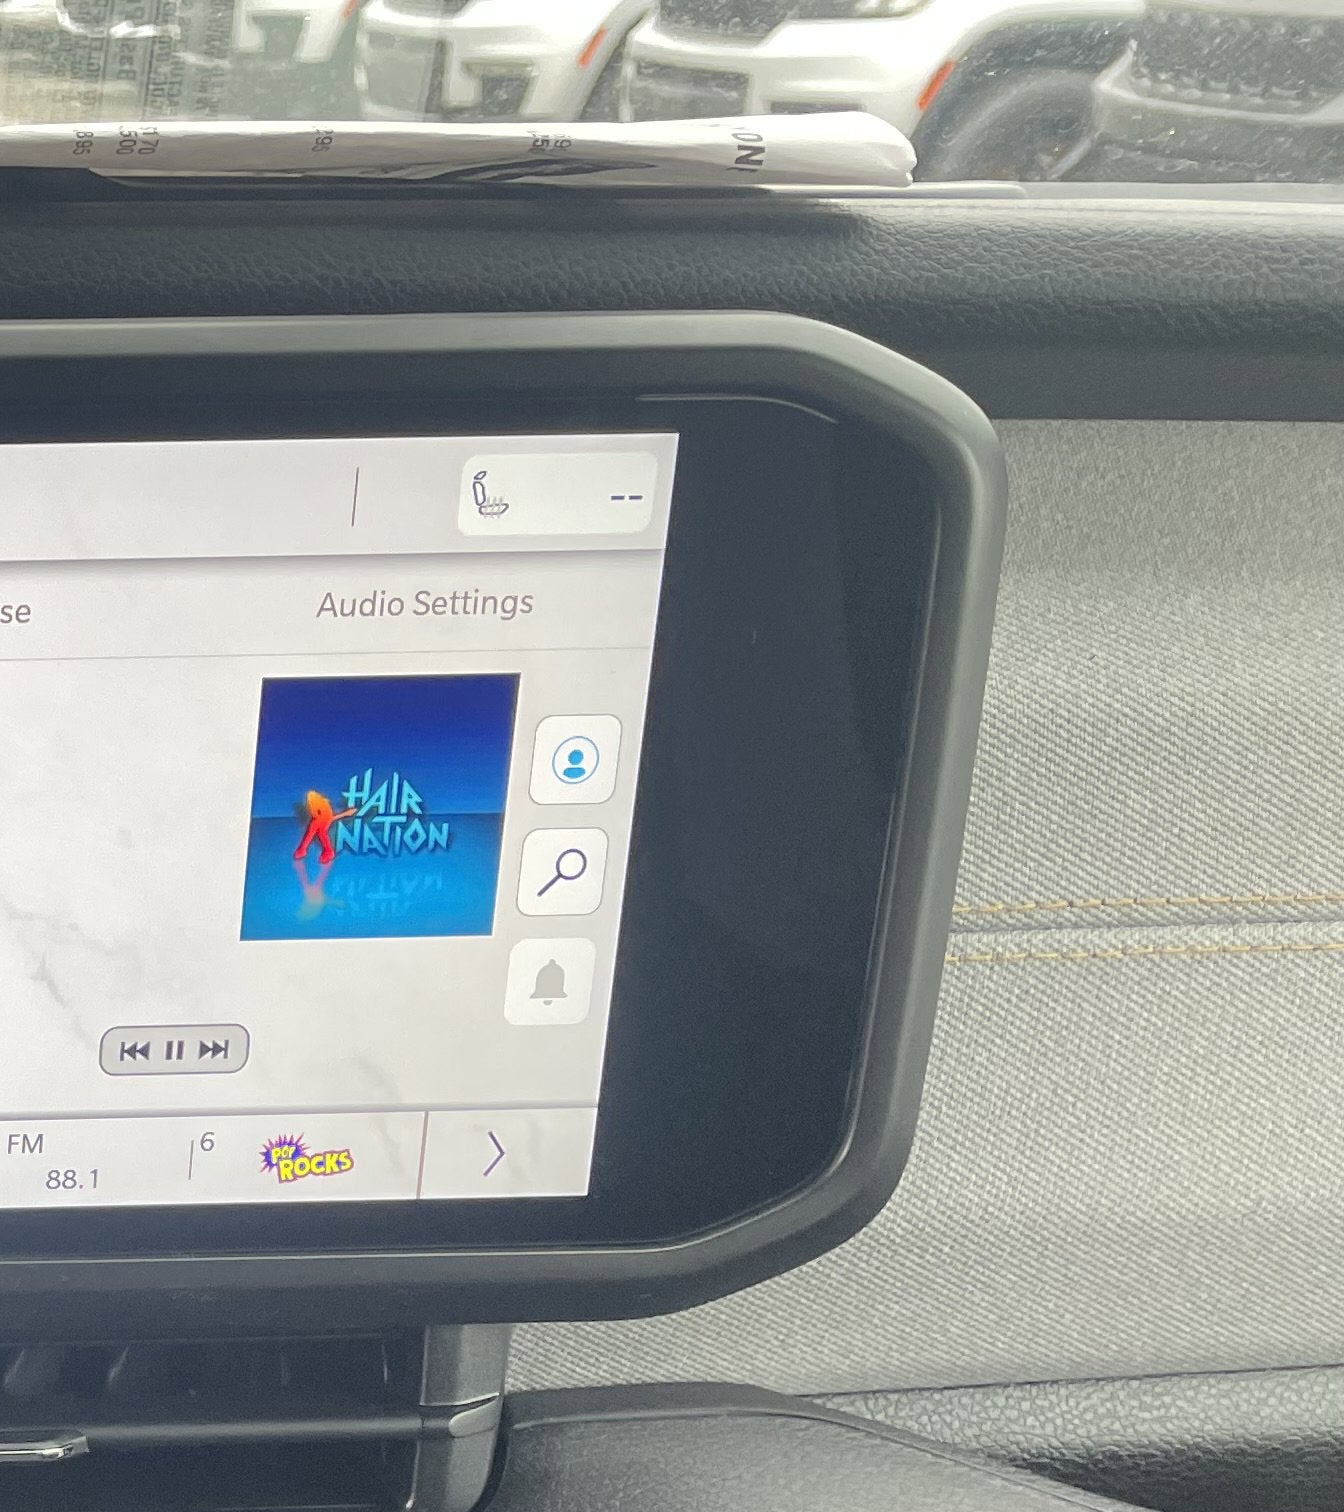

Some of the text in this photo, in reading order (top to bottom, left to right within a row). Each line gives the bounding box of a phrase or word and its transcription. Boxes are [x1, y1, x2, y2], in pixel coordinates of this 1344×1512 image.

[315, 588, 534, 621] Audio Settings
[341, 767, 423, 817] HAIR
[334, 815, 450, 857] NATION
[7, 1133, 44, 1155] FM
[199, 1131, 215, 1152] 6
[45, 1168, 98, 1190] 88.1
[277, 1150, 353, 1182] ROCKS
